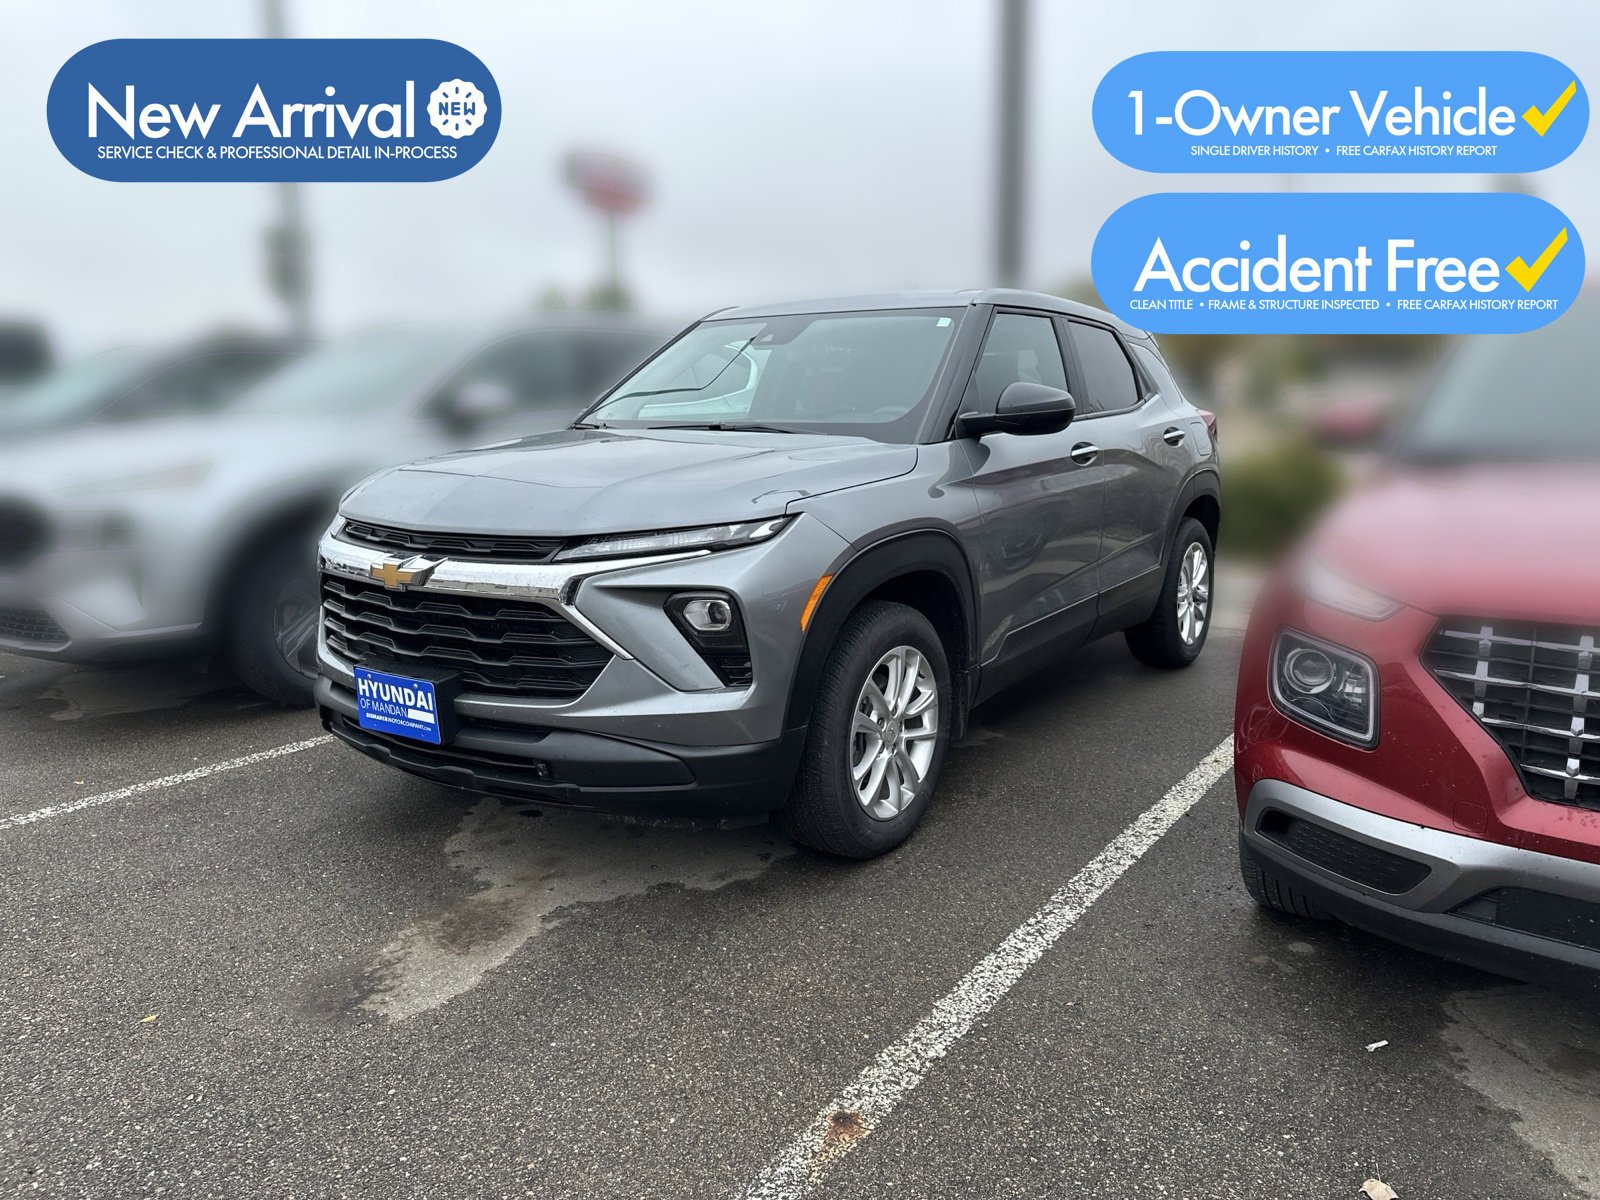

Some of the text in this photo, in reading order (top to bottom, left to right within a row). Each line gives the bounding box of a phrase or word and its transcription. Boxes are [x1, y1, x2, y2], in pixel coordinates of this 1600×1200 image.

[358, 678, 433, 711] HYUNDAI
[360, 698, 408, 718] OF MANDAN
